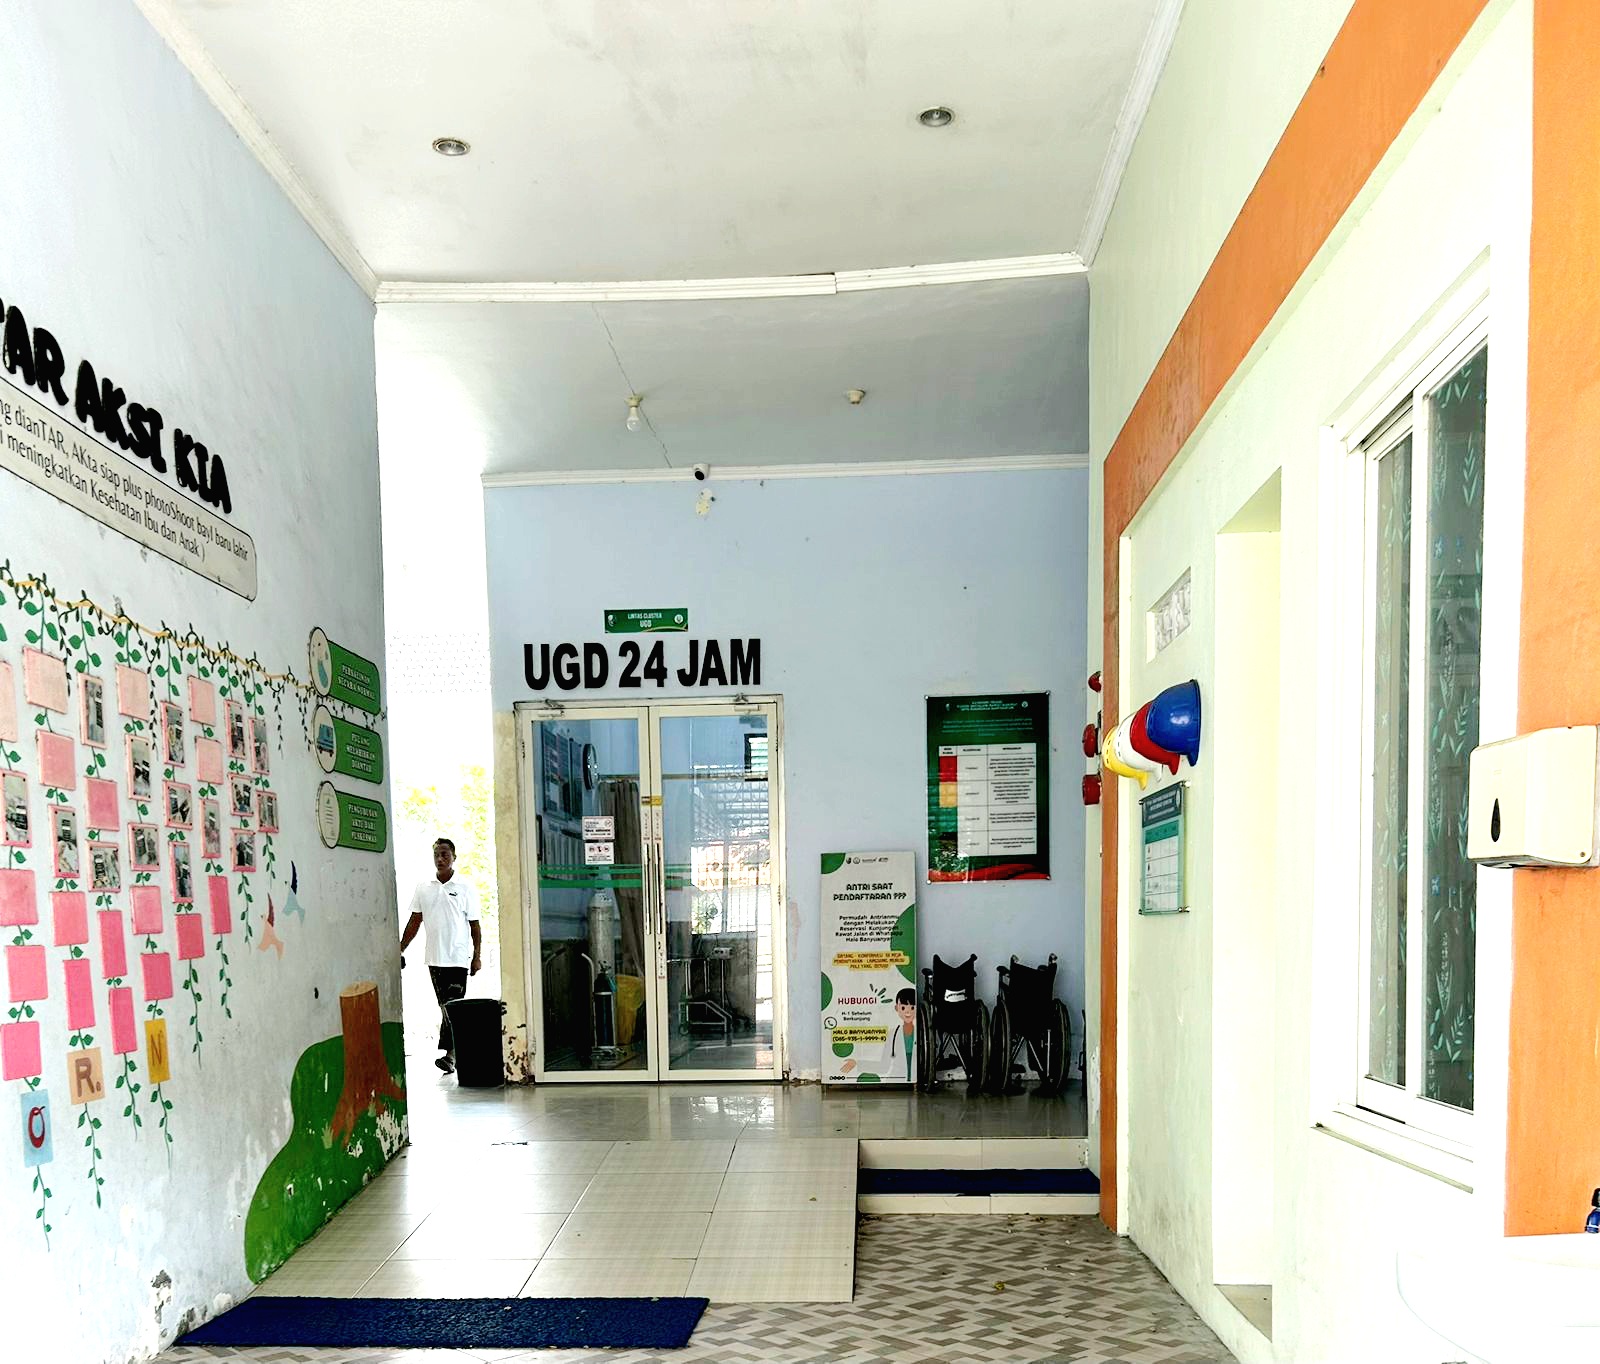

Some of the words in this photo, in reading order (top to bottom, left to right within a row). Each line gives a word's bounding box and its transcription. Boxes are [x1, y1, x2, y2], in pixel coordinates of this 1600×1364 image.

[75, 360, 168, 473] AKSI
[174, 428, 232, 514] KIA
[7, 432, 88, 495] meningkatkan
[91, 479, 141, 525] Kesehatan
[144, 510, 159, 533] Ibu
[161, 521, 177, 544] dan
[179, 532, 200, 557] Anak
[72, 441, 98, 474] AKta
[100, 462, 120, 491] siap
[123, 475, 143, 500] plus
[145, 489, 195, 531] photoShoot
[215, 528, 231, 552] baru
[233, 538, 249, 561] lahir
[639, 619, 652, 628] UGD
[523, 642, 609, 691] UGD
[618, 640, 668, 688] 24
[677, 638, 761, 687] JAM
[833, 893, 892, 901] PENDAFTARAN
[838, 997, 877, 1005] HUBUNGI
